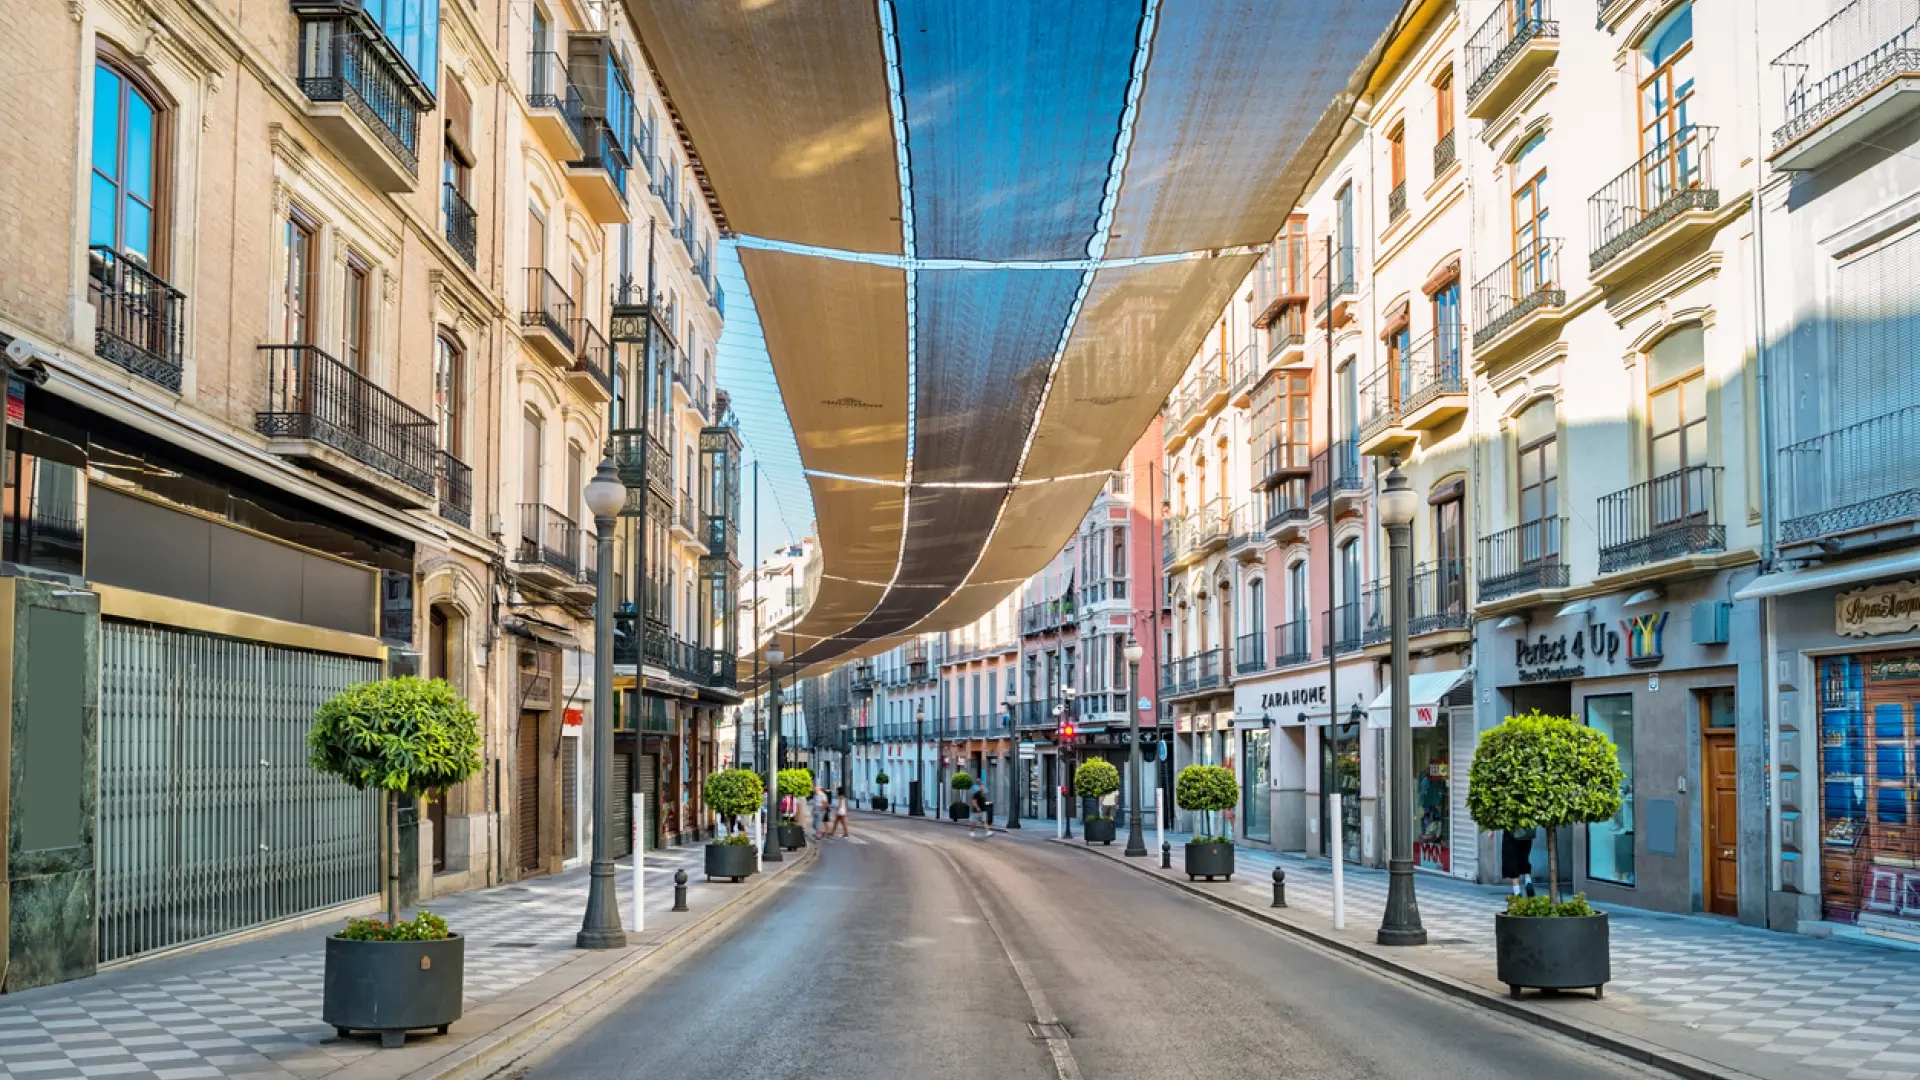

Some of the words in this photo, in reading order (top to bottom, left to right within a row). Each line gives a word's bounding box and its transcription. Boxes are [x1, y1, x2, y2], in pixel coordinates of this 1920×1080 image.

[1515, 634, 1567, 667] Perfect
[1571, 630, 1585, 660] 4
[1590, 622, 1620, 664] Up
[1261, 691, 1290, 709] ZARA
[1292, 685, 1326, 705] HOME
